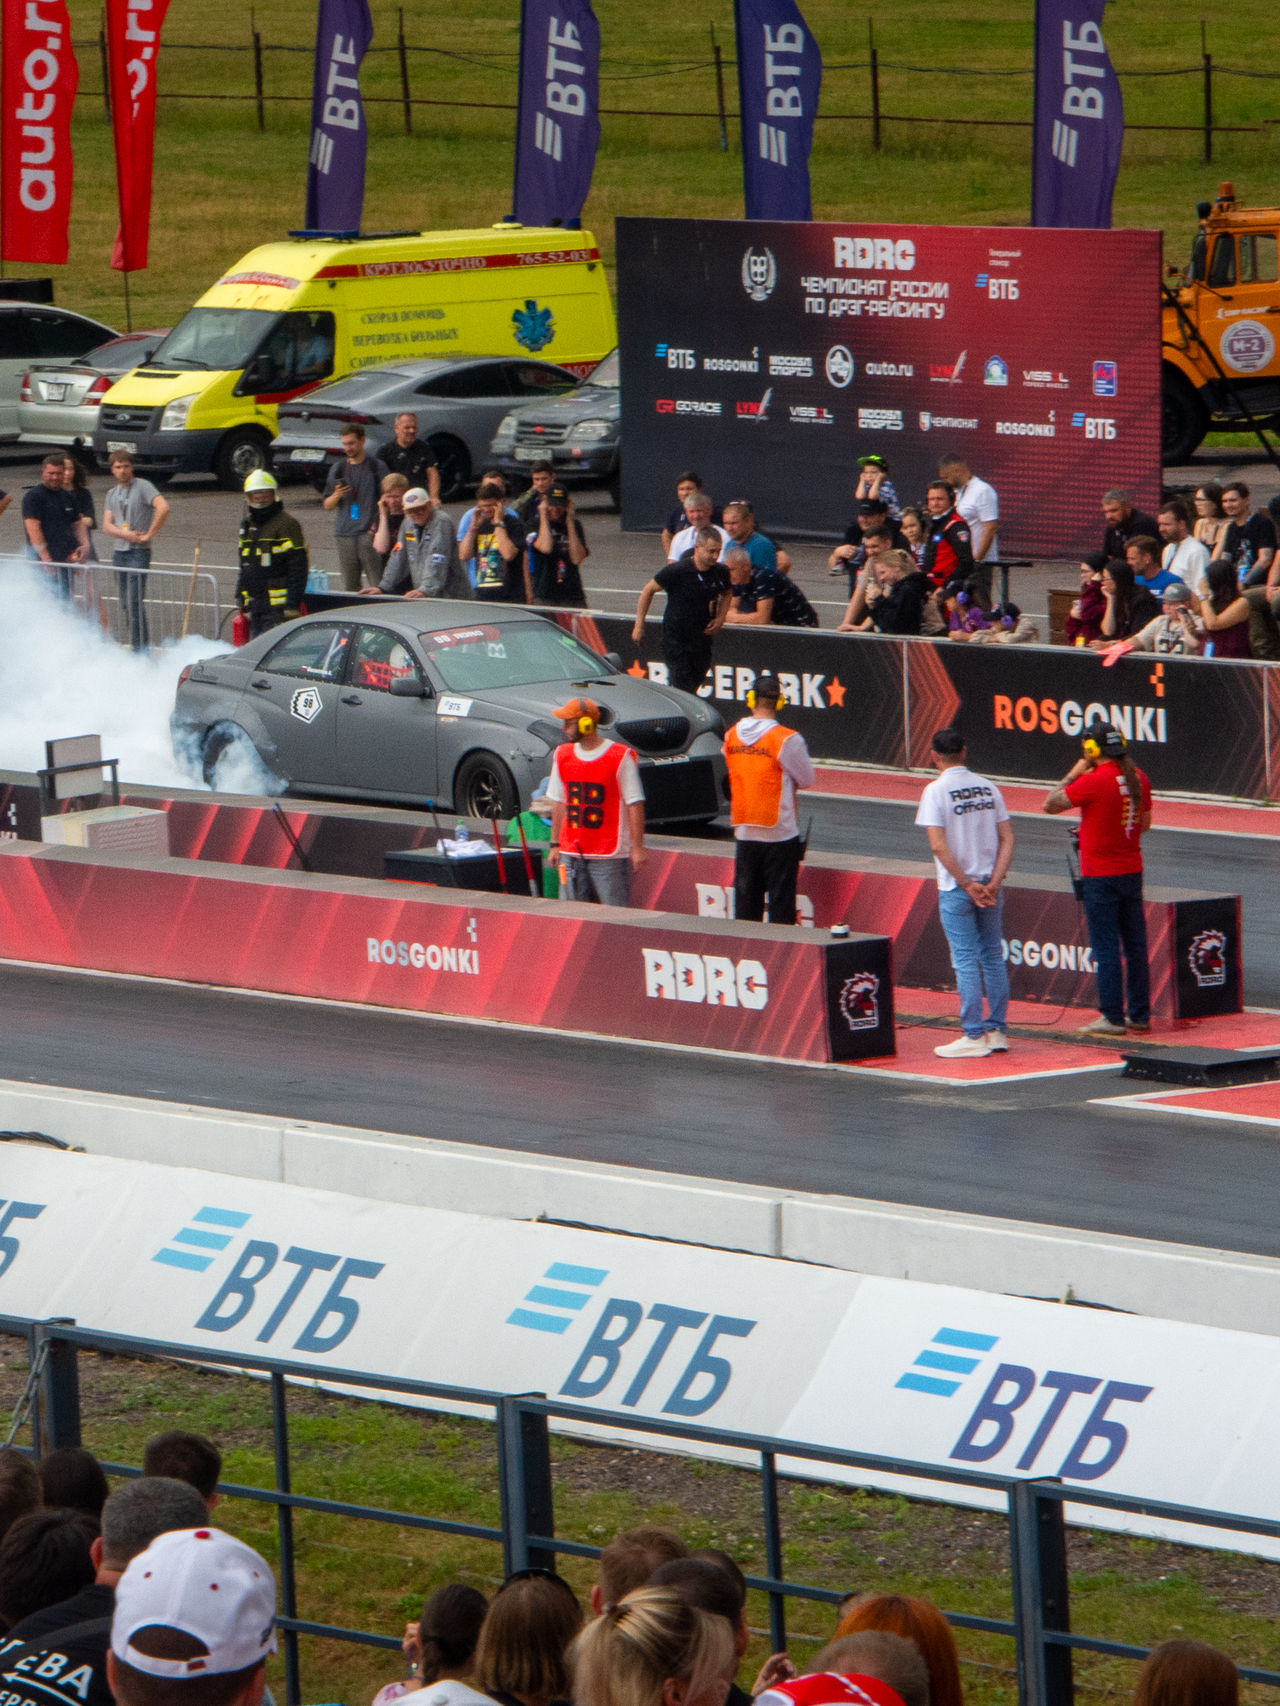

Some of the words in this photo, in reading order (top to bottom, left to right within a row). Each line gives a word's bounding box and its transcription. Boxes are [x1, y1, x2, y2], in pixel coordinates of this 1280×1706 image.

[545, 16, 586, 117] ВТБ
[763, 23, 804, 117] ВТБ
[1062, 20, 1106, 119] ВТБ
[322, 33, 360, 131] ВТБ
[16, 0, 62, 211] auto.r
[364, 257, 487, 277] КРУГЛОСУТОЧНО
[517, 250, 588, 266] 765-52-03
[833, 237, 916, 270] RDRC
[801, 276, 887, 297] ЧЕМПИОНАТ
[891, 280, 949, 299] РОССИИ
[988, 279, 1020, 300] ВТБ
[805, 297, 825, 314] ПО
[828, 296, 945, 319] ДРЭГ-РЕЙСИНГУ
[668, 349, 696, 370] ВТБ
[703, 358, 759, 373] ROSGONKI
[865, 362, 914, 377] auto.ru
[675, 401, 722, 413] GORACE
[930, 416, 979, 429] ЧЕМПИОНАТ
[995, 422, 1056, 437] ROSGONKI
[1085, 418, 1117, 440] ВТБ
[646, 661, 827, 709] RCEPRK
[949, 786, 993, 802] RDRC
[953, 800, 996, 816] Official
[367, 937, 480, 975] ROSGONKI
[642, 947, 769, 1010] RDRC
[193, 1240, 386, 1353] ВТБ
[557, 1298, 758, 1417] ВТБ
[949, 1362, 1155, 1482] ВТБ
